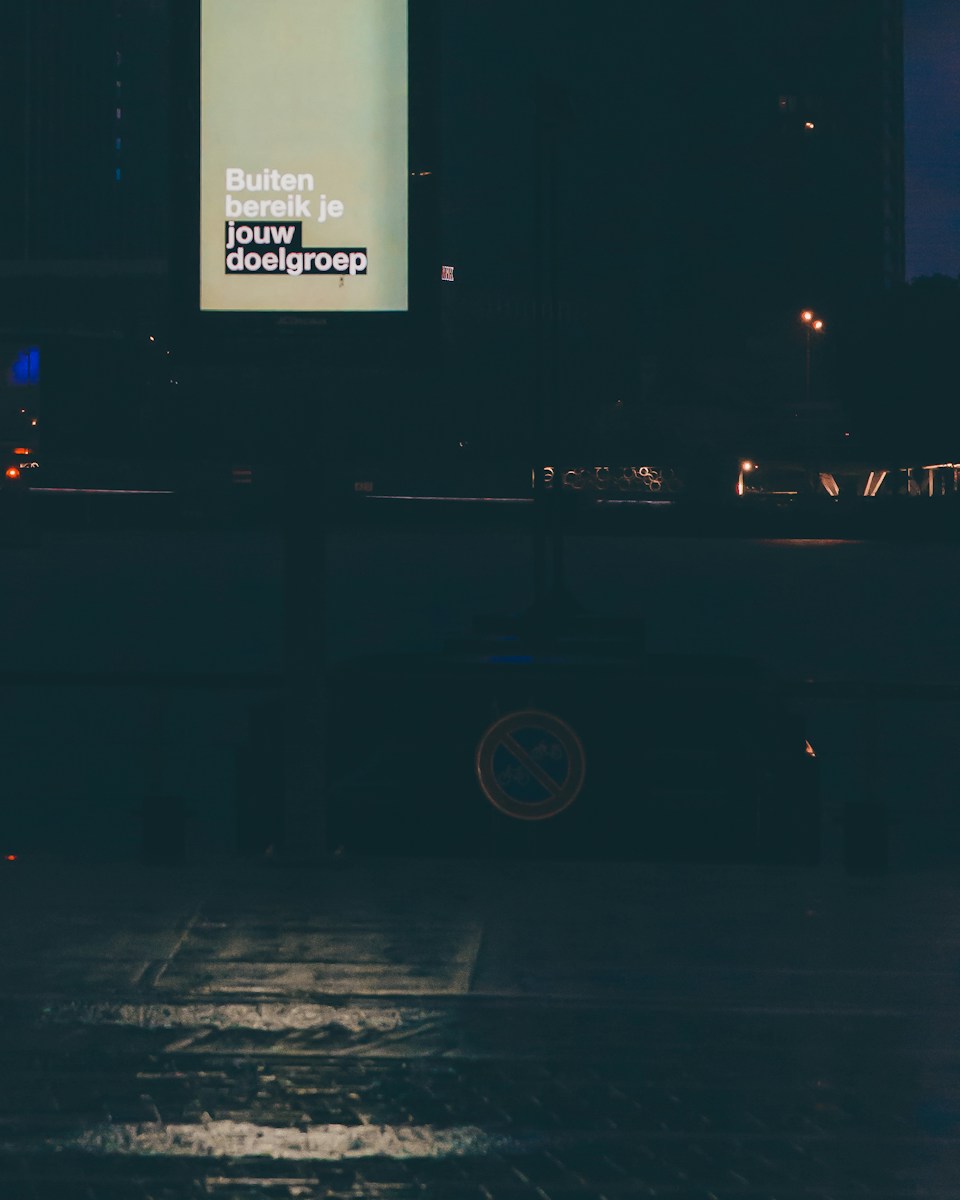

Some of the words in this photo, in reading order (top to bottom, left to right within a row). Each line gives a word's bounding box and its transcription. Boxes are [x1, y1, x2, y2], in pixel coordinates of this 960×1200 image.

[225, 168, 315, 192] Buiten
[225, 195, 312, 219] bereik
[318, 195, 345, 224] je
[225, 221, 296, 248] jouw
[226, 247, 369, 276] doelgroep
